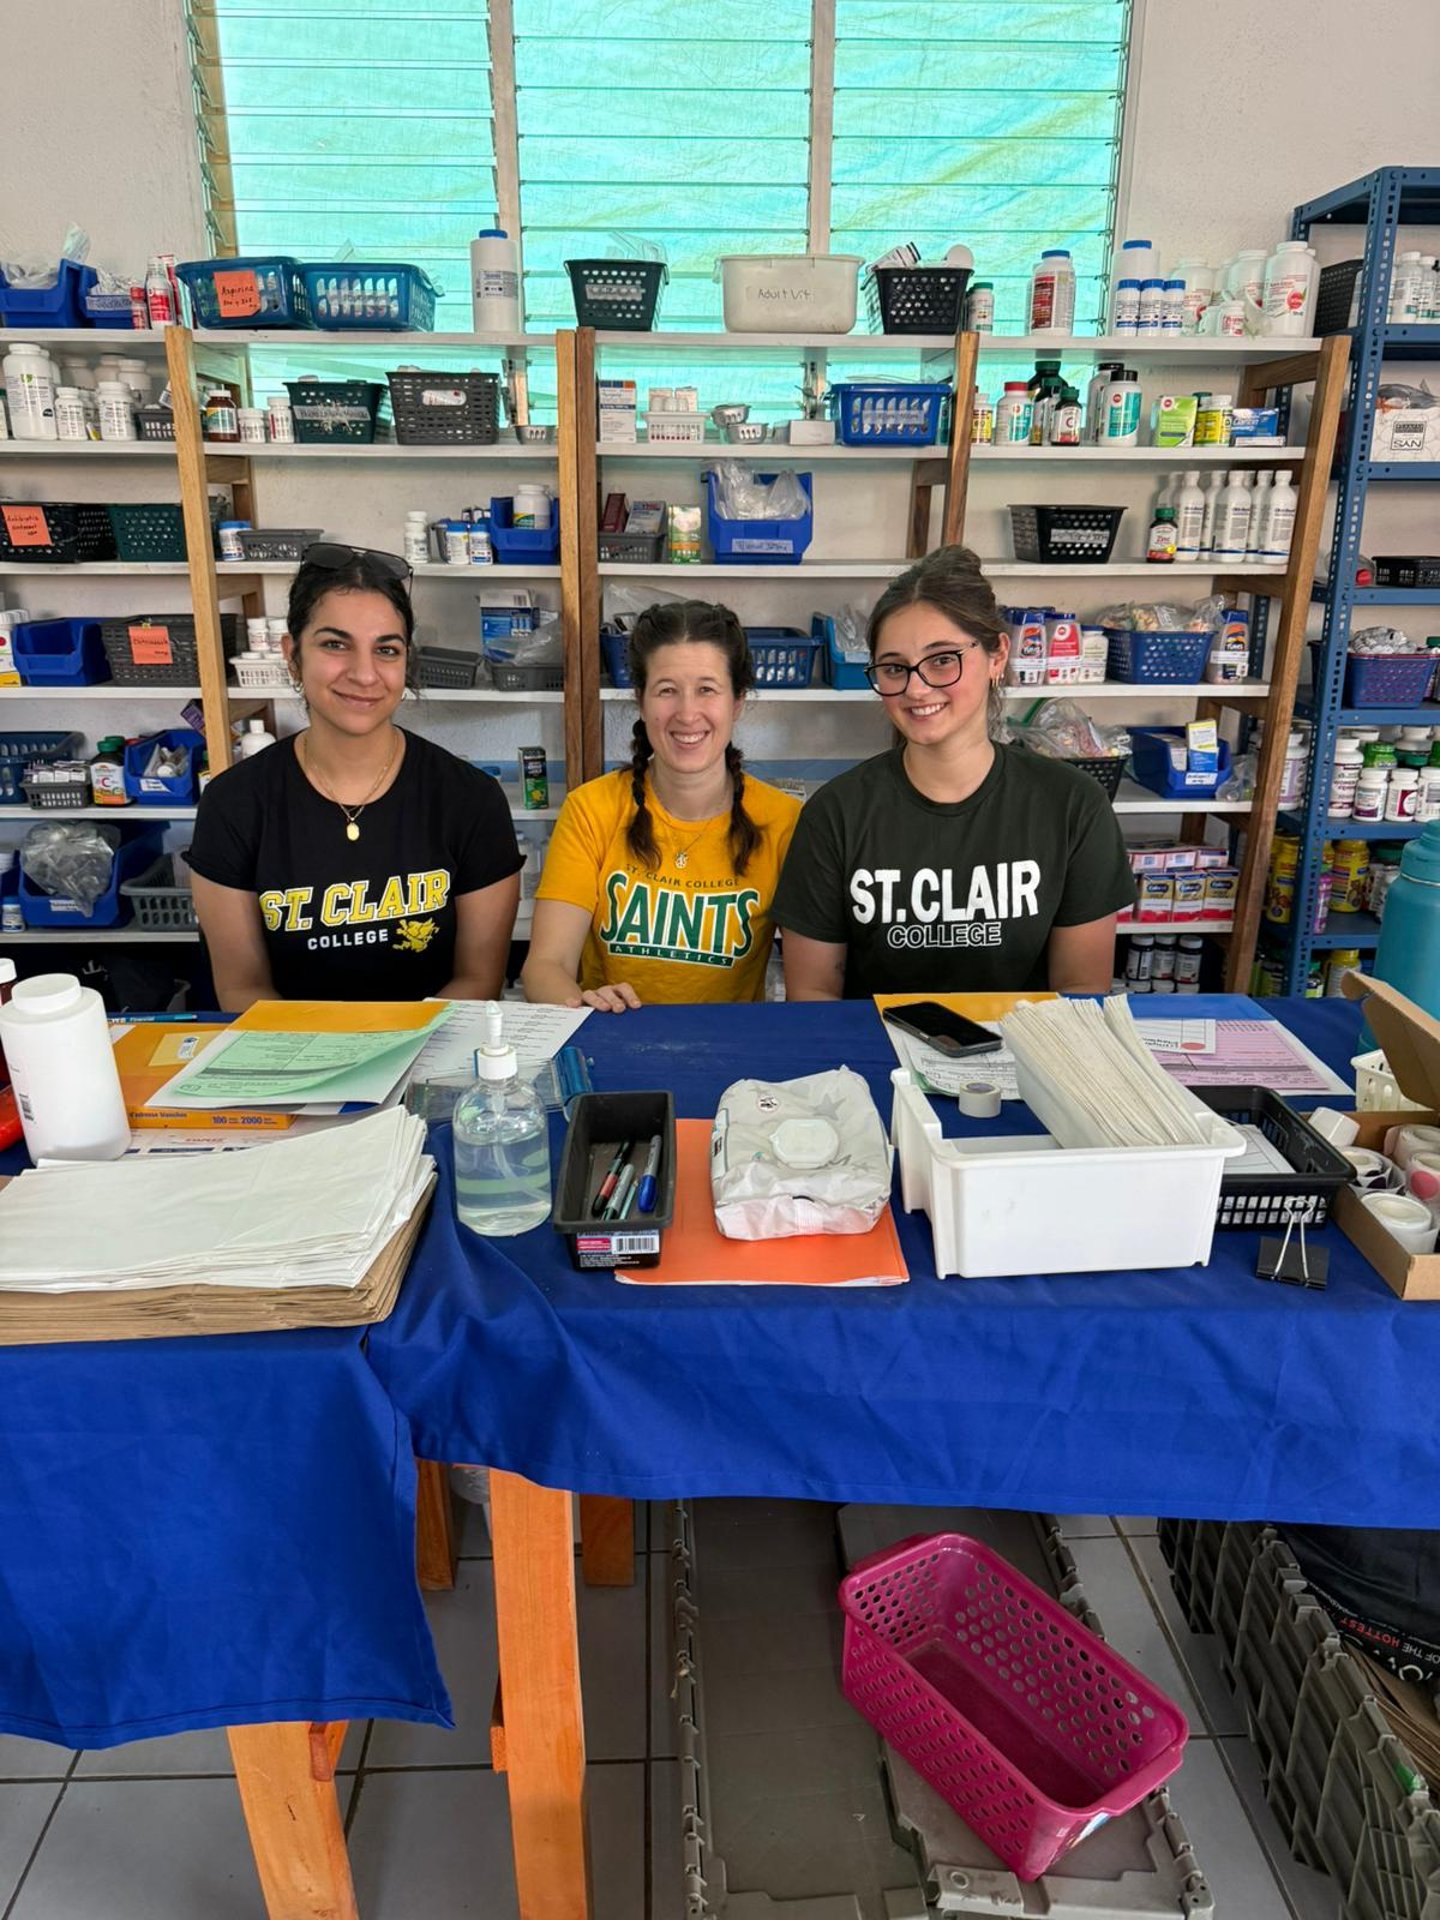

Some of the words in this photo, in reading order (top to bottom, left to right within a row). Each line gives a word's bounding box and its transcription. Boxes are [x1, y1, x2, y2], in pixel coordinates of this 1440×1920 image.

[758, 289, 787, 300] Adult
[790, 289, 811, 300] Vit
[259, 887, 313, 931] ST.
[320, 868, 450, 927] CLAIR
[600, 870, 760, 959] SAINTS
[307, 929, 388, 950] COLLEGE
[887, 922, 1002, 949] COLLEGE
[615, 945, 728, 965] ATHLETICS
[213, 1116, 227, 1124] 100
[1340, 1617, 1400, 1648] HOTTEST
[1402, 1642, 1423, 1659] THE
